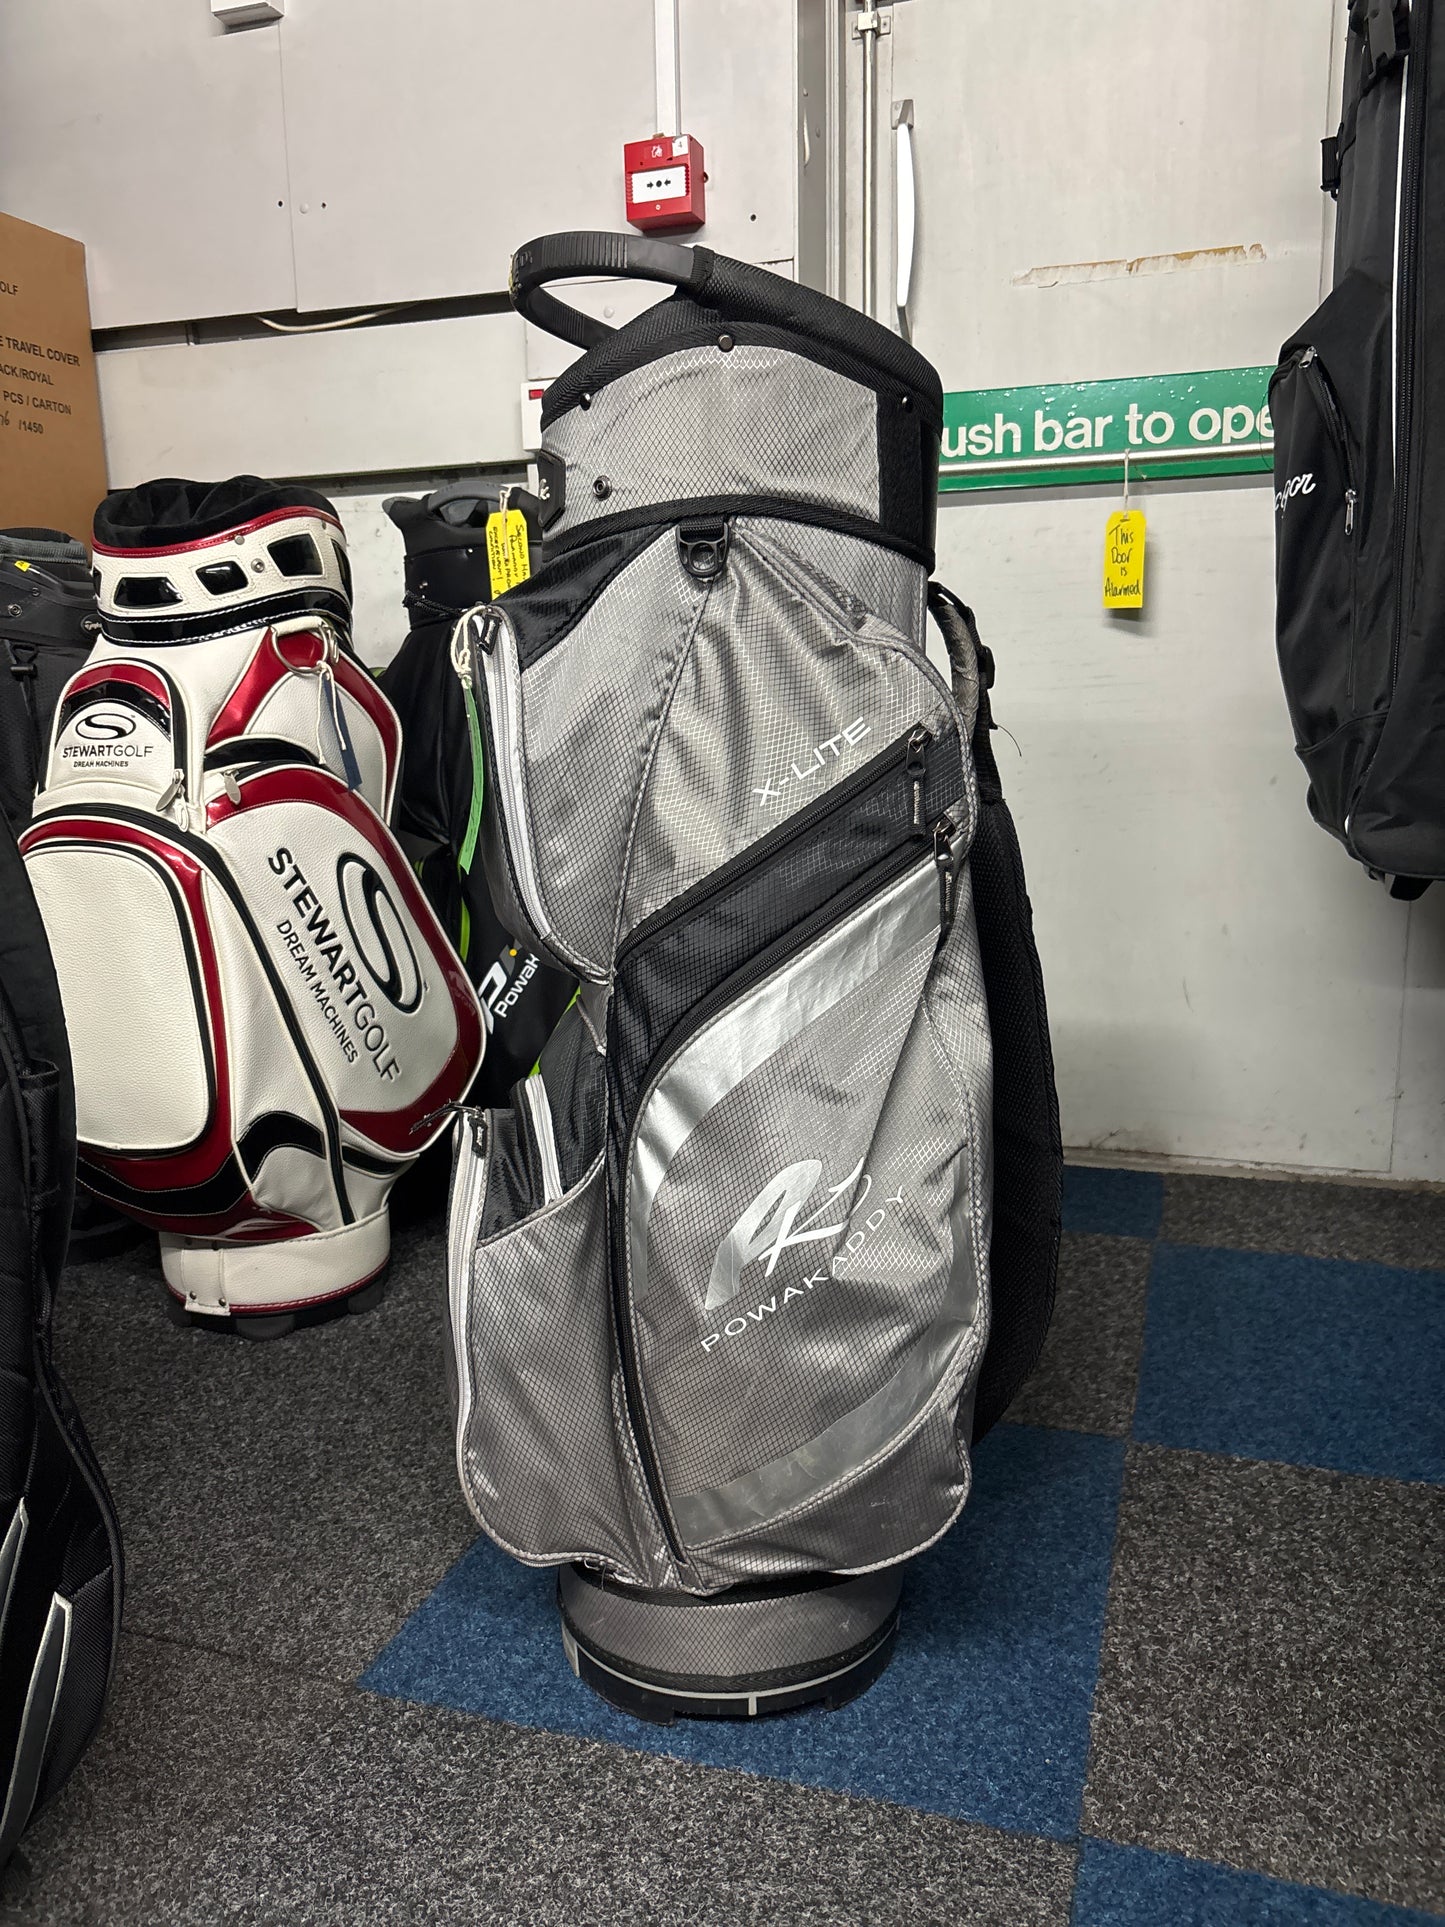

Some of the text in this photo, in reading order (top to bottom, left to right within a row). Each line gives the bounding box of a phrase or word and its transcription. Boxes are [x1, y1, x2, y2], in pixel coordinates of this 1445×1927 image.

[6, 337, 45, 358] TRAVEL
[47, 347, 80, 367] COVER
[3, 390, 24, 405] PCS
[32, 396, 72, 415] CARTON
[1034, 409, 1114, 452] bar
[1125, 403, 1176, 446] to
[1109, 524, 1134, 545] This
[1111, 547, 1133, 563] Door
[1104, 577, 1141, 597] Alarmed
[62, 745, 154, 758] STEWARTGOLF
[752, 716, 871, 806] X-LITE
[268, 847, 400, 1082] STEWARTGOLF
[277, 920, 358, 1063] DREAM MACHINES
[701, 1185, 904, 1353] POWAKADDY
